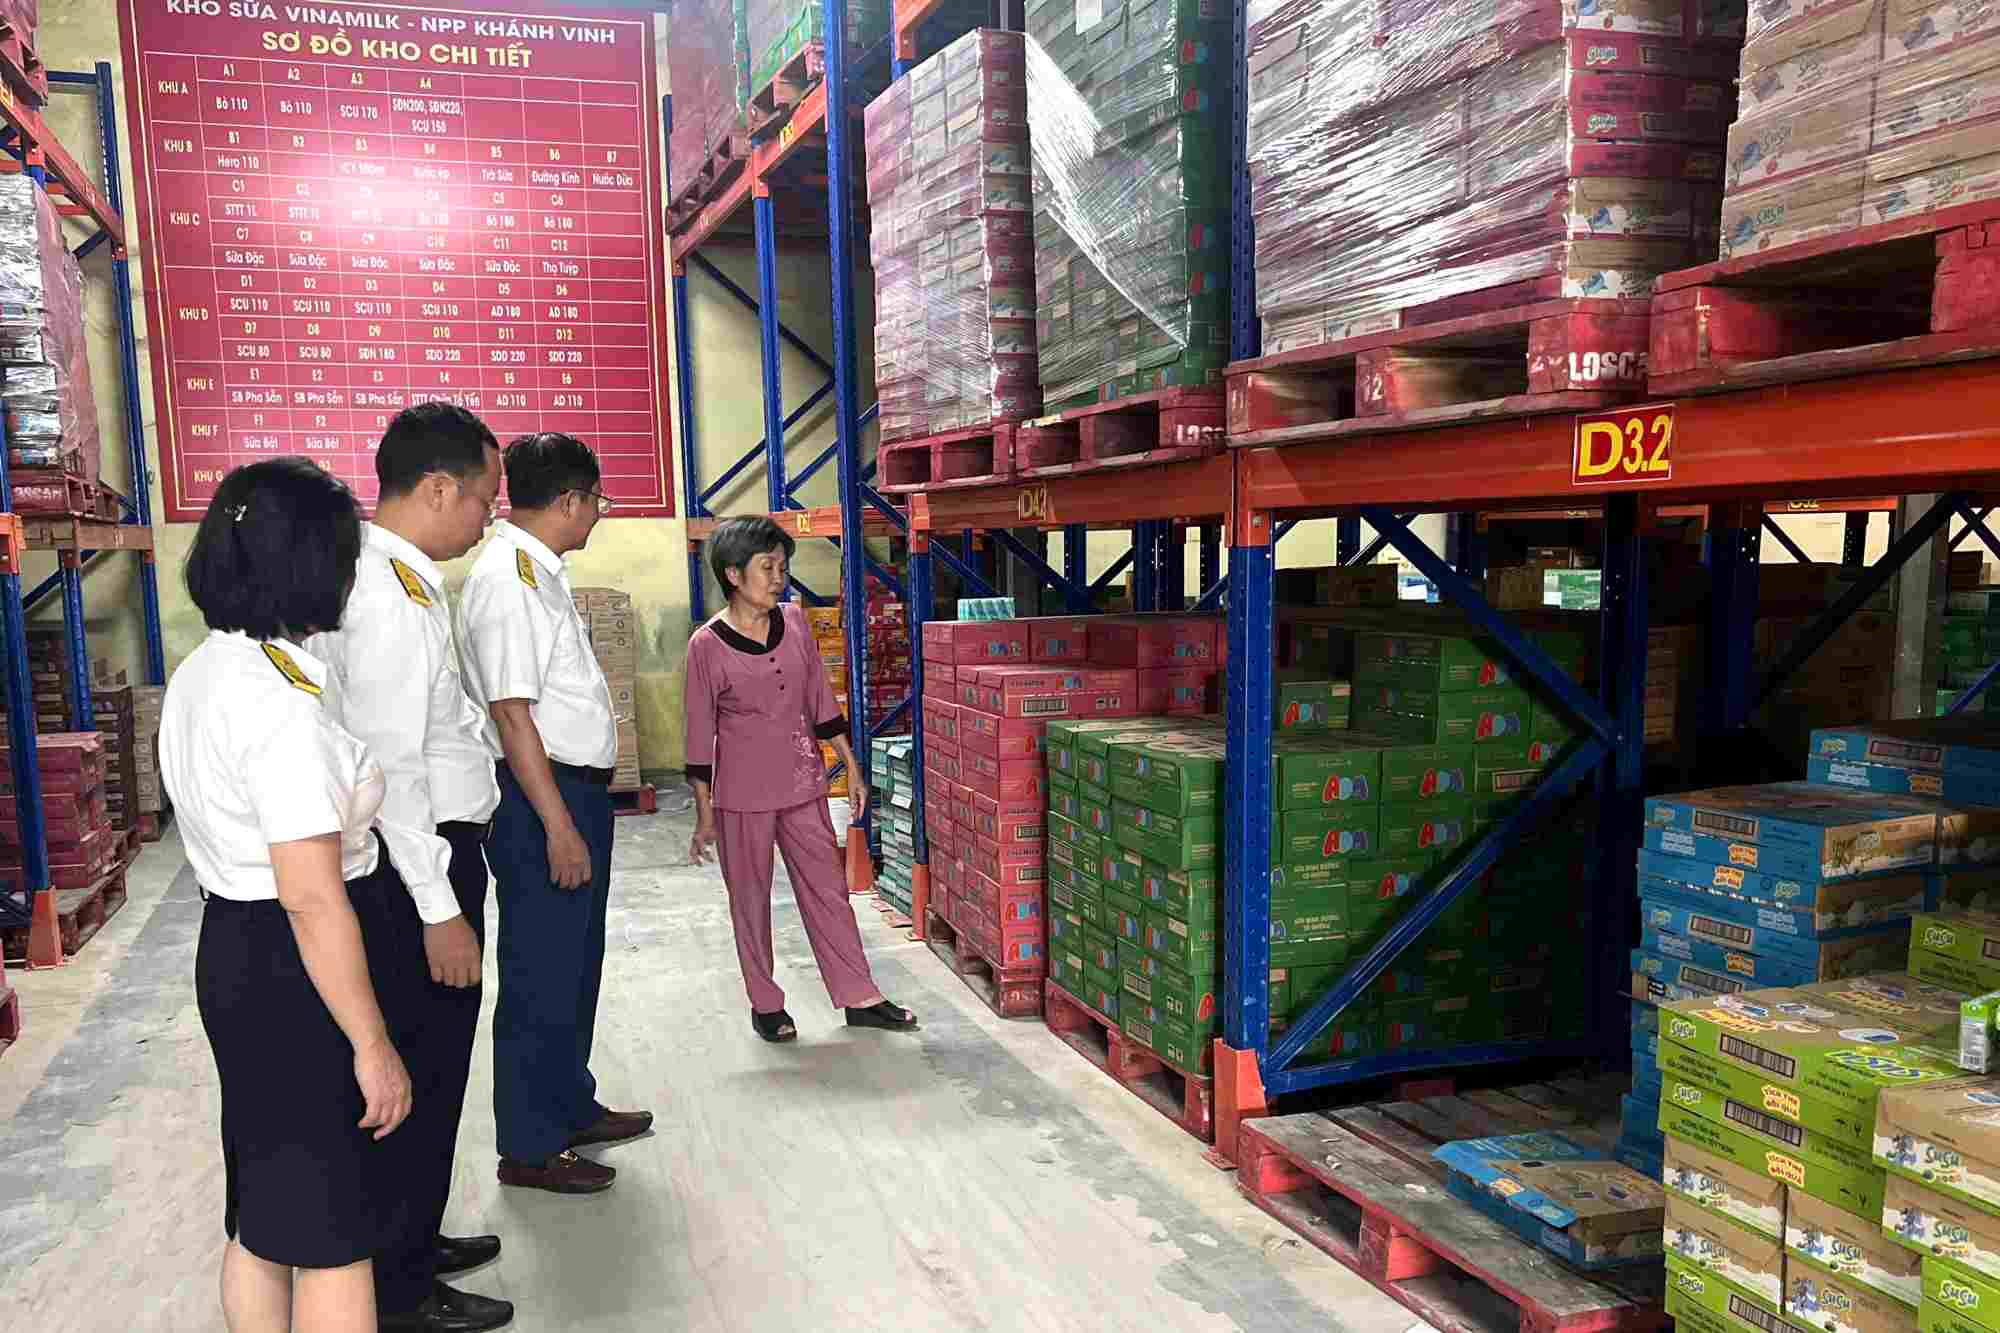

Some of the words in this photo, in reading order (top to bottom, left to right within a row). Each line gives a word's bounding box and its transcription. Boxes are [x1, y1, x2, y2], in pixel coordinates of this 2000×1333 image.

[229, 1, 276, 20] SỮA
[285, 6, 400, 29] VINAMILK
[421, 17, 467, 34] NPP
[474, 19, 554, 39] KHÁNH
[561, 27, 616, 43] VINH
[262, 31, 300, 51] SƠ
[309, 28, 351, 56] ĐỒ
[362, 39, 421, 61] KHO
[429, 43, 477, 65] CHI
[485, 41, 532, 68] TIẾT
[223, 64, 234, 76] A1
[288, 68, 300, 80] A2
[158, 81, 178, 93] KHU
[181, 84, 188, 94] A
[420, 78, 432, 89] A4
[295, 102, 312, 114] 110
[164, 140, 184, 152] KHU
[186, 141, 193, 152] B
[242, 156, 259, 169] 110
[232, 180, 245, 193] C1
[170, 213, 190, 225] KHU
[192, 213, 200, 225] C
[304, 278, 316, 289] D2
[251, 299, 268, 311] 110
[314, 302, 330, 313] 110
[375, 303, 392, 314] 110
[180, 309, 198, 320] KHU
[200, 309, 208, 321] D
[187, 379, 207, 391] KHU
[192, 425, 211, 436] KHU
[1578, 414, 1671, 477] D3.2
[194, 471, 213, 482] KHU
